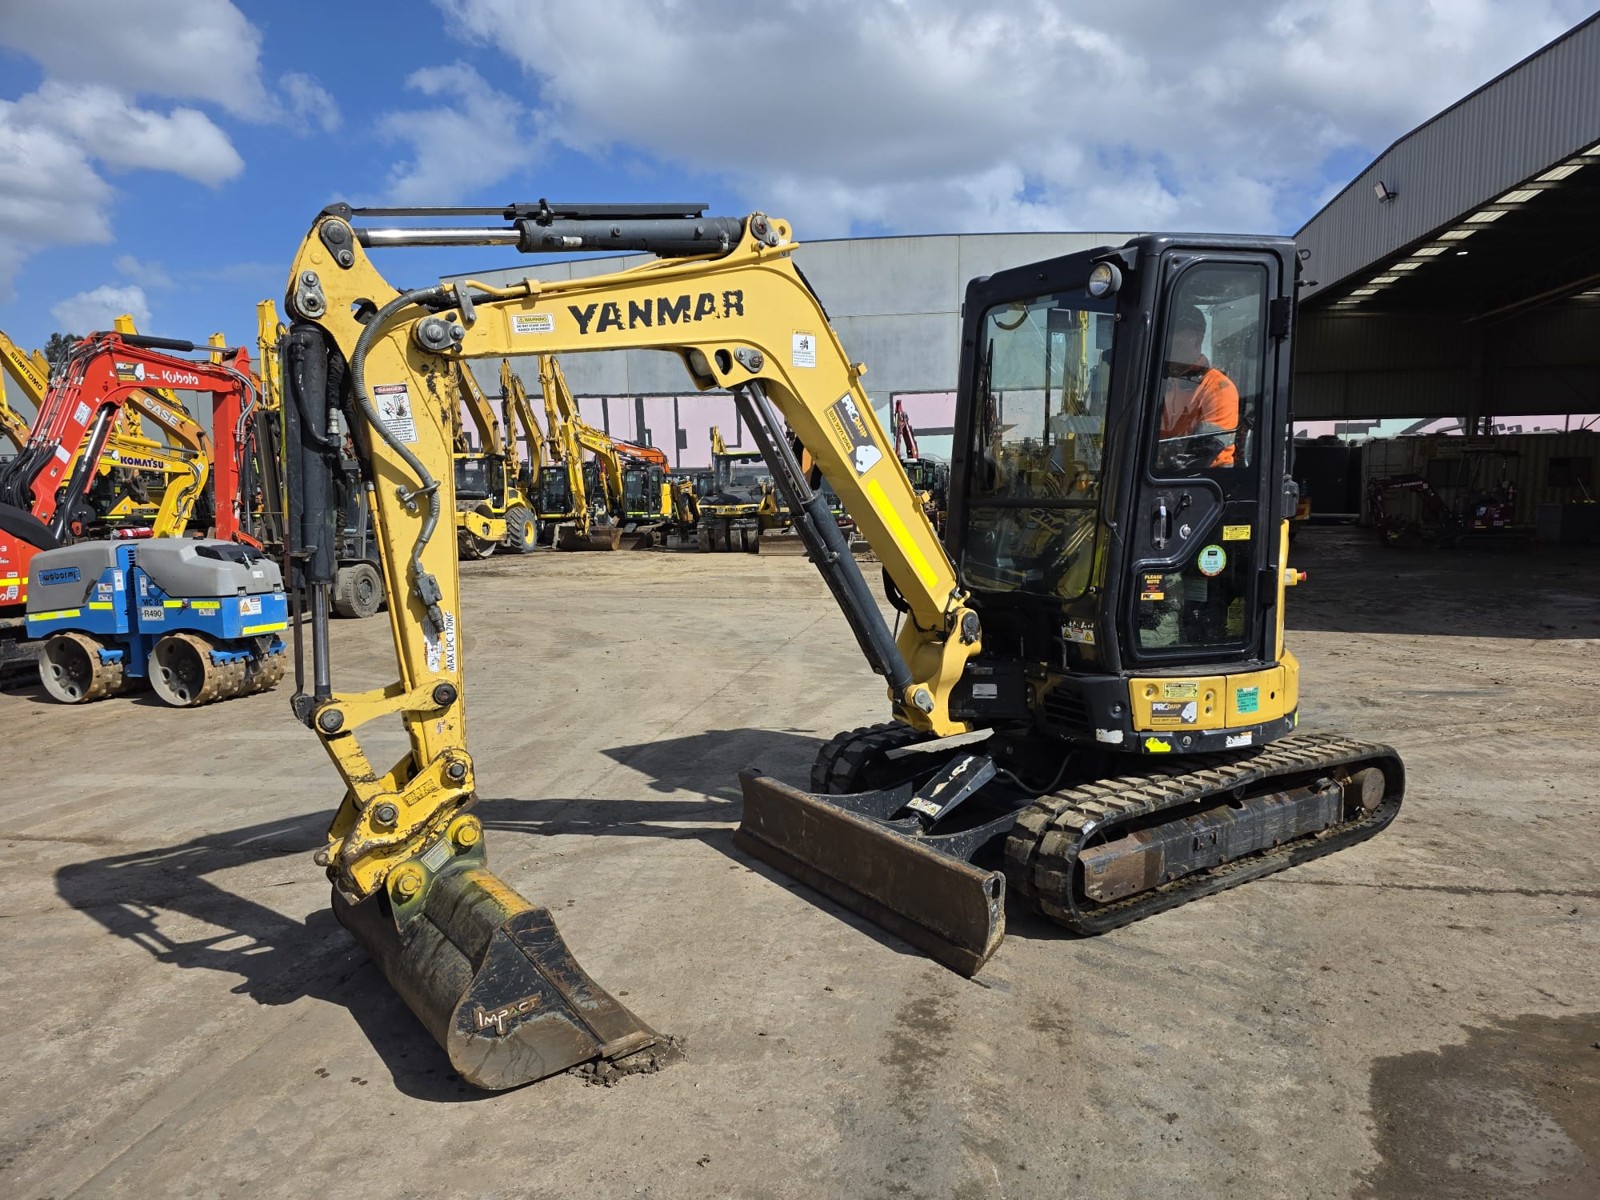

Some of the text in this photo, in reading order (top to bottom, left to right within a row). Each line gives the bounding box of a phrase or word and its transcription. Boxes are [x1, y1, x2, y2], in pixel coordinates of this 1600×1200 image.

[567, 289, 744, 335] YANMAR
[10, 351, 43, 391] SUMITOMO
[162, 370, 199, 385] Kubota
[143, 397, 179, 427] CASE
[120, 456, 164, 469] KOMATSU
[144, 609, 162, 618] R490
[446, 636, 455, 652] LPC
[446, 655, 455, 671] MAX
